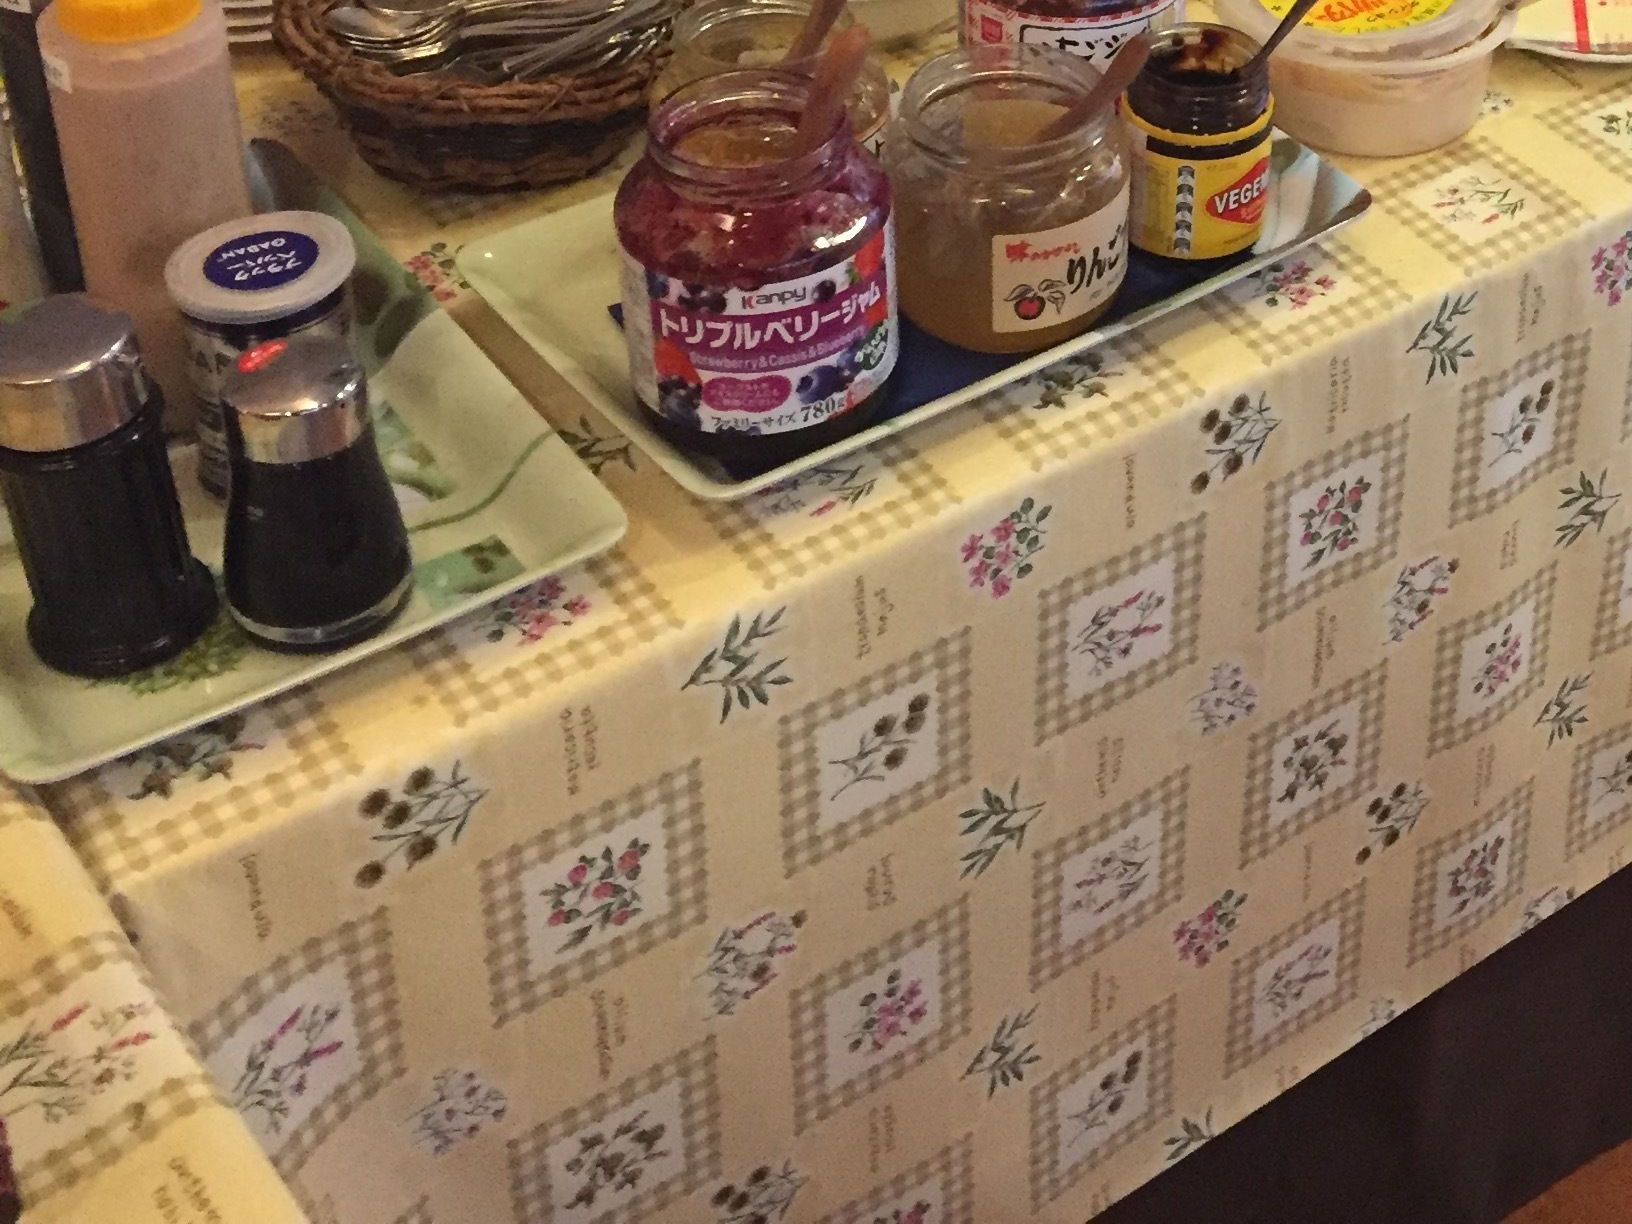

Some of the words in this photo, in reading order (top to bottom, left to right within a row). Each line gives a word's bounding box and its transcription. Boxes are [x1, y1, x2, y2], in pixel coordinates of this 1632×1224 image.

[660, 280, 882, 350] トリプルベリージャム
[741, 286, 807, 309] Kanpy
